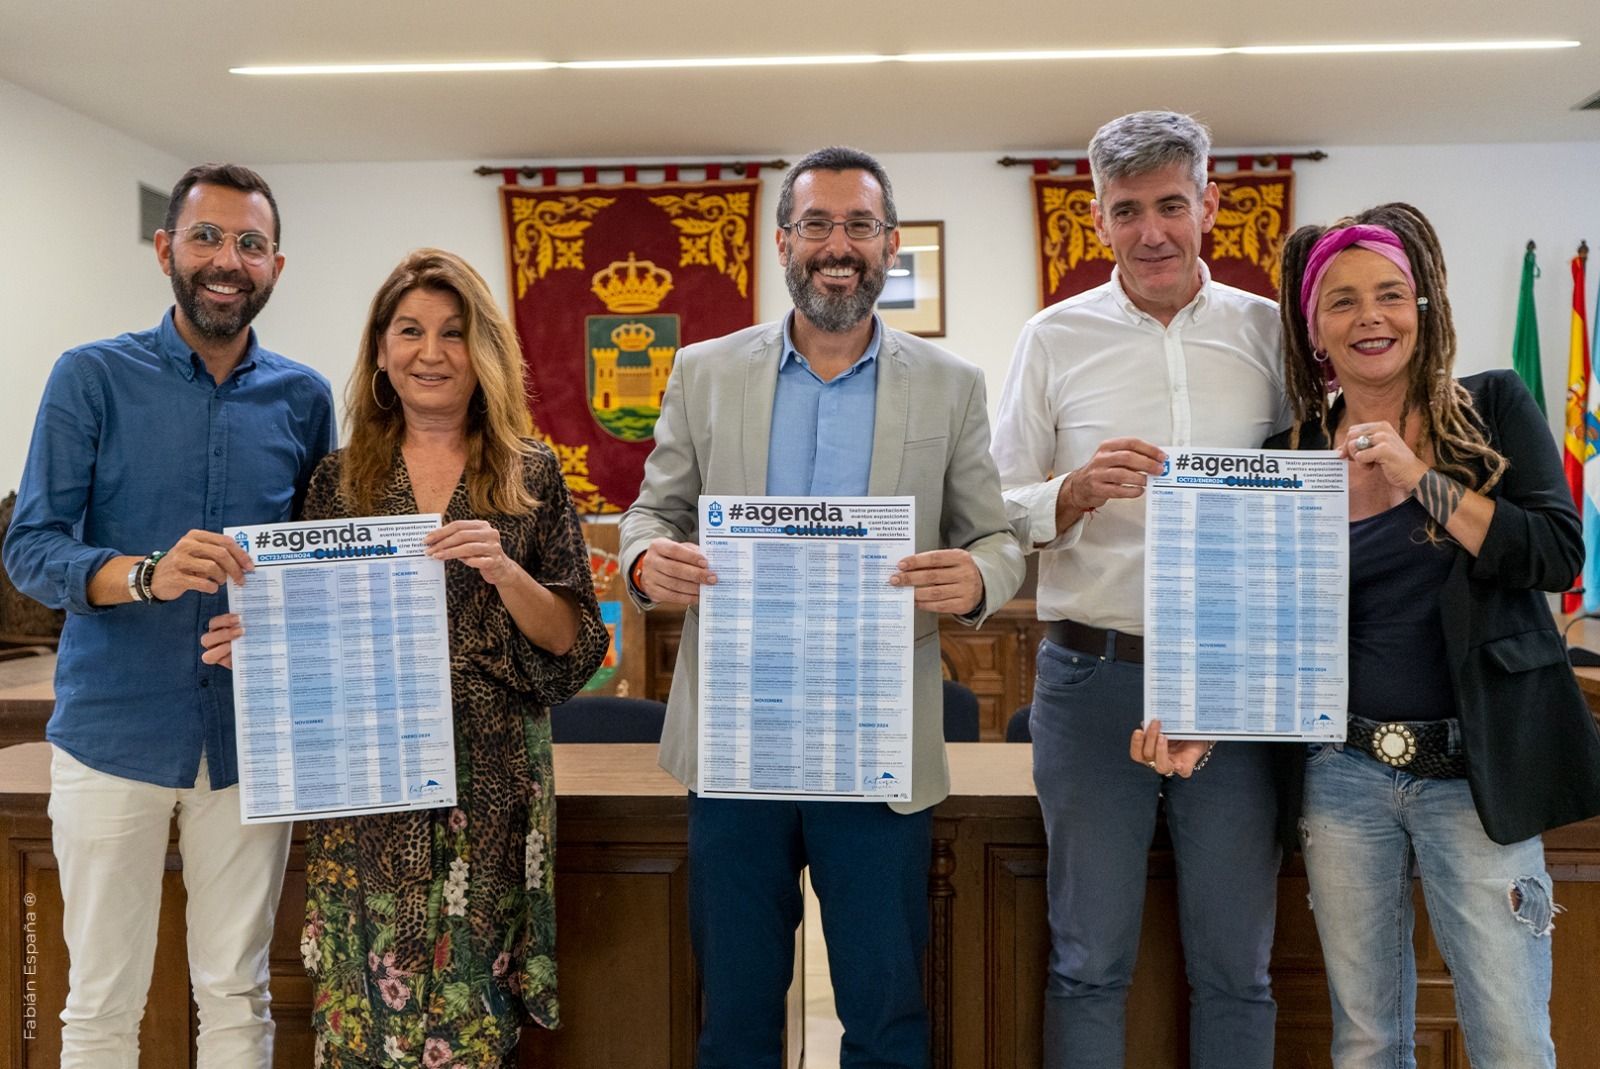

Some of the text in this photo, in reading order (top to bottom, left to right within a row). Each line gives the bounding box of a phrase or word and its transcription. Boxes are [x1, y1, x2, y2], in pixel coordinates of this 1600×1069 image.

[1176, 454, 1279, 476] #agenda
[1226, 473, 1300, 488] cultural
[728, 502, 843, 526] #agenda
[255, 523, 372, 551] #agenda
[784, 522, 864, 537] cultural
[259, 540, 394, 561] OCT23/ENERO24 cultural
